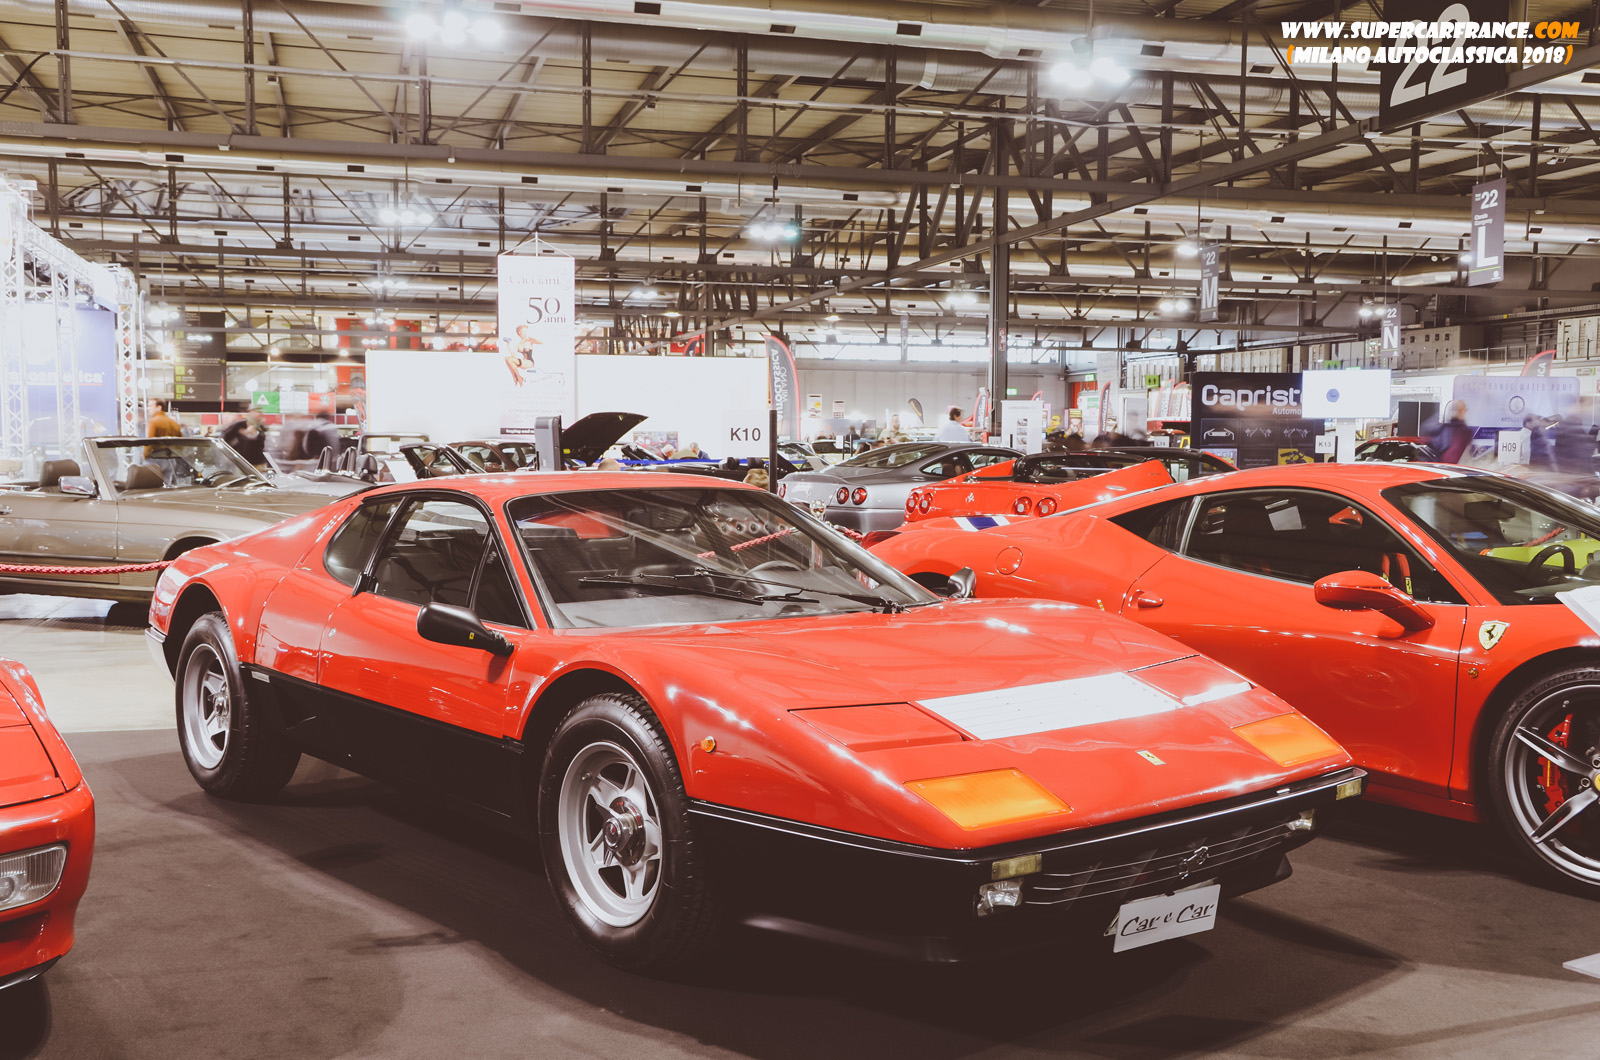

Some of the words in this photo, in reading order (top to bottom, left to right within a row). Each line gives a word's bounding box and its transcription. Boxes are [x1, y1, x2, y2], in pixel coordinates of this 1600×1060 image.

[1390, 3, 1470, 107] 22
[1480, 189, 1499, 210] 22
[1206, 251, 1216, 265] 22
[1476, 226, 1499, 268] L
[1202, 276, 1218, 309] M
[526, 296, 561, 324] 50
[544, 313, 567, 323] anni
[1386, 308, 1397, 318] 22
[1383, 325, 1399, 349] N
[1201, 384, 1303, 411] Caprist
[730, 427, 762, 441] K10
[1318, 440, 1332, 448] K13
[1501, 442, 1517, 452] H09
[1120, 916, 1161, 937] Car
[1176, 903, 1215, 924] Car
